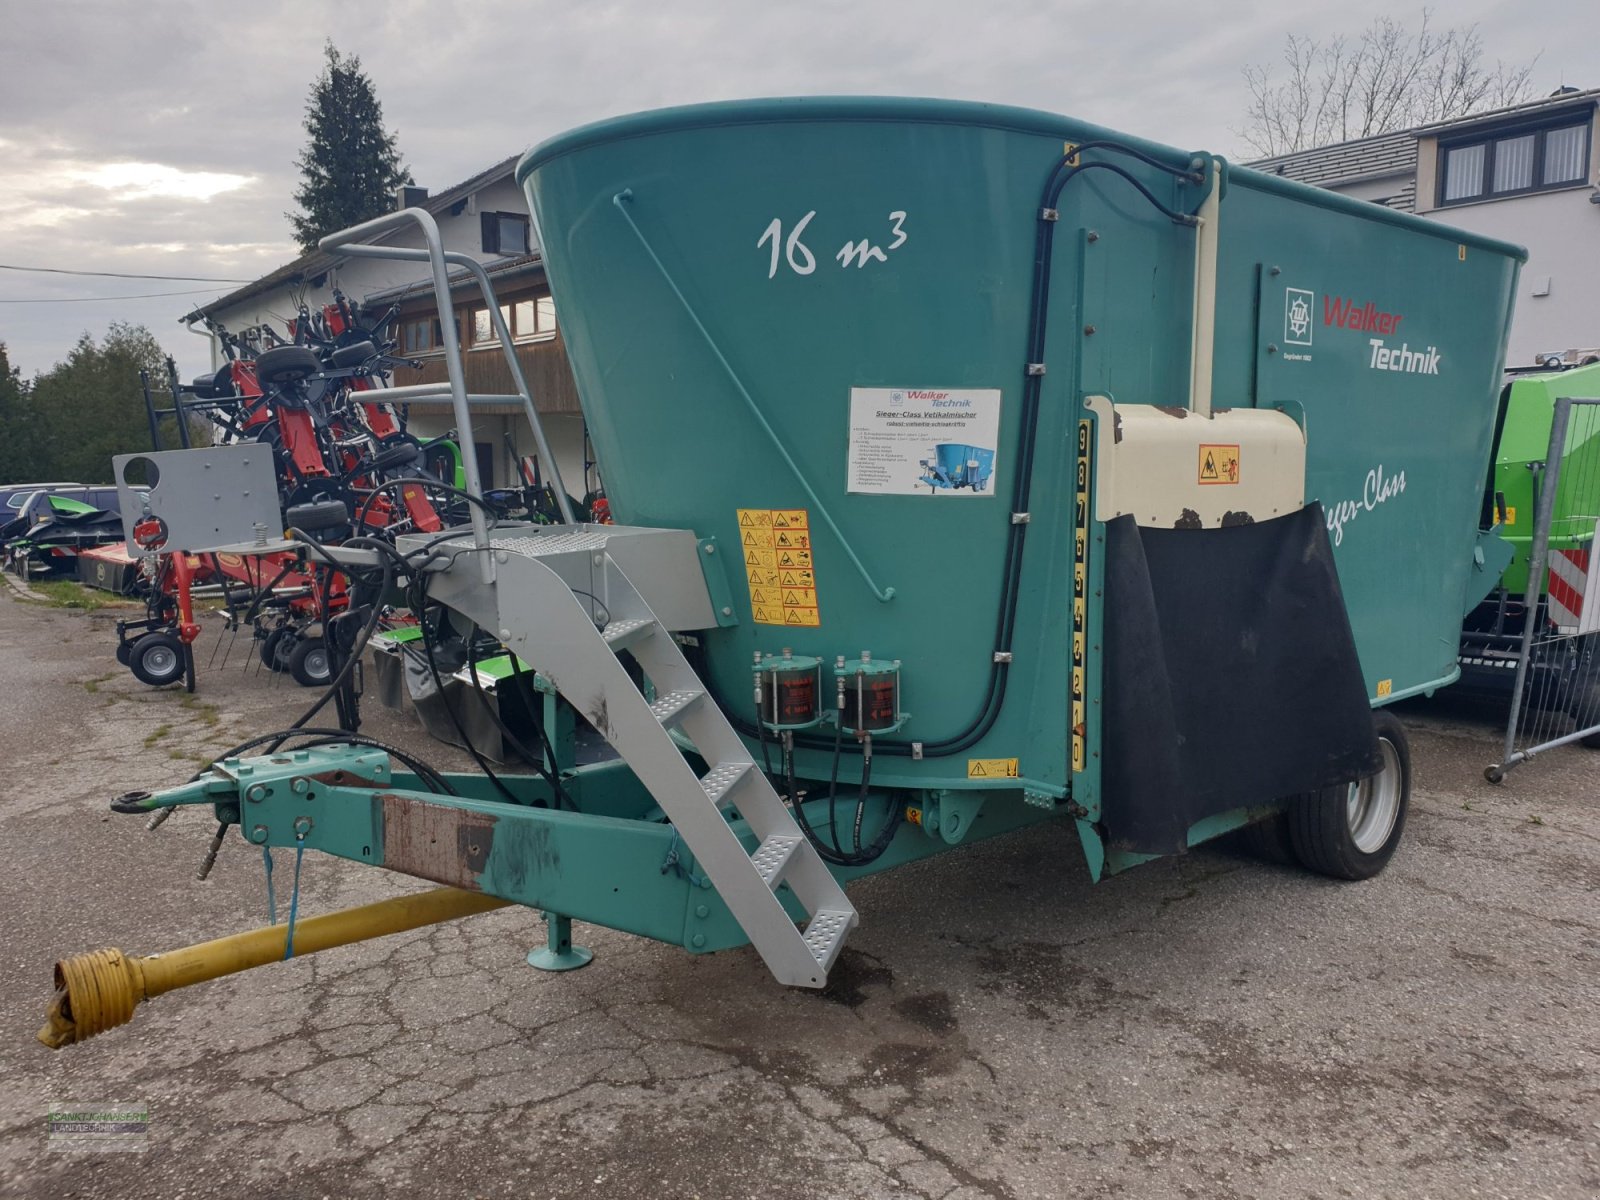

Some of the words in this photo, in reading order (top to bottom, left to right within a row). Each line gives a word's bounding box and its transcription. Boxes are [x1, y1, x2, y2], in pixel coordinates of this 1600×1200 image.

[757, 210, 817, 279] 16
[1323, 294, 1404, 335] Walker
[1369, 338, 1441, 375] Technik
[907, 391, 949, 400] Walker
[931, 399, 972, 408] Technik
[1079, 429, 1086, 450] 9
[1078, 464, 1084, 486] 8
[1078, 499, 1084, 521] 7
[1076, 535, 1082, 556] 6
[1075, 570, 1081, 591] 5
[1074, 605, 1080, 625] 4
[1074, 639, 1080, 660] 3
[1074, 673, 1080, 695] 2
[1074, 708, 1079, 728] 1
[1073, 742, 1079, 762] 0
